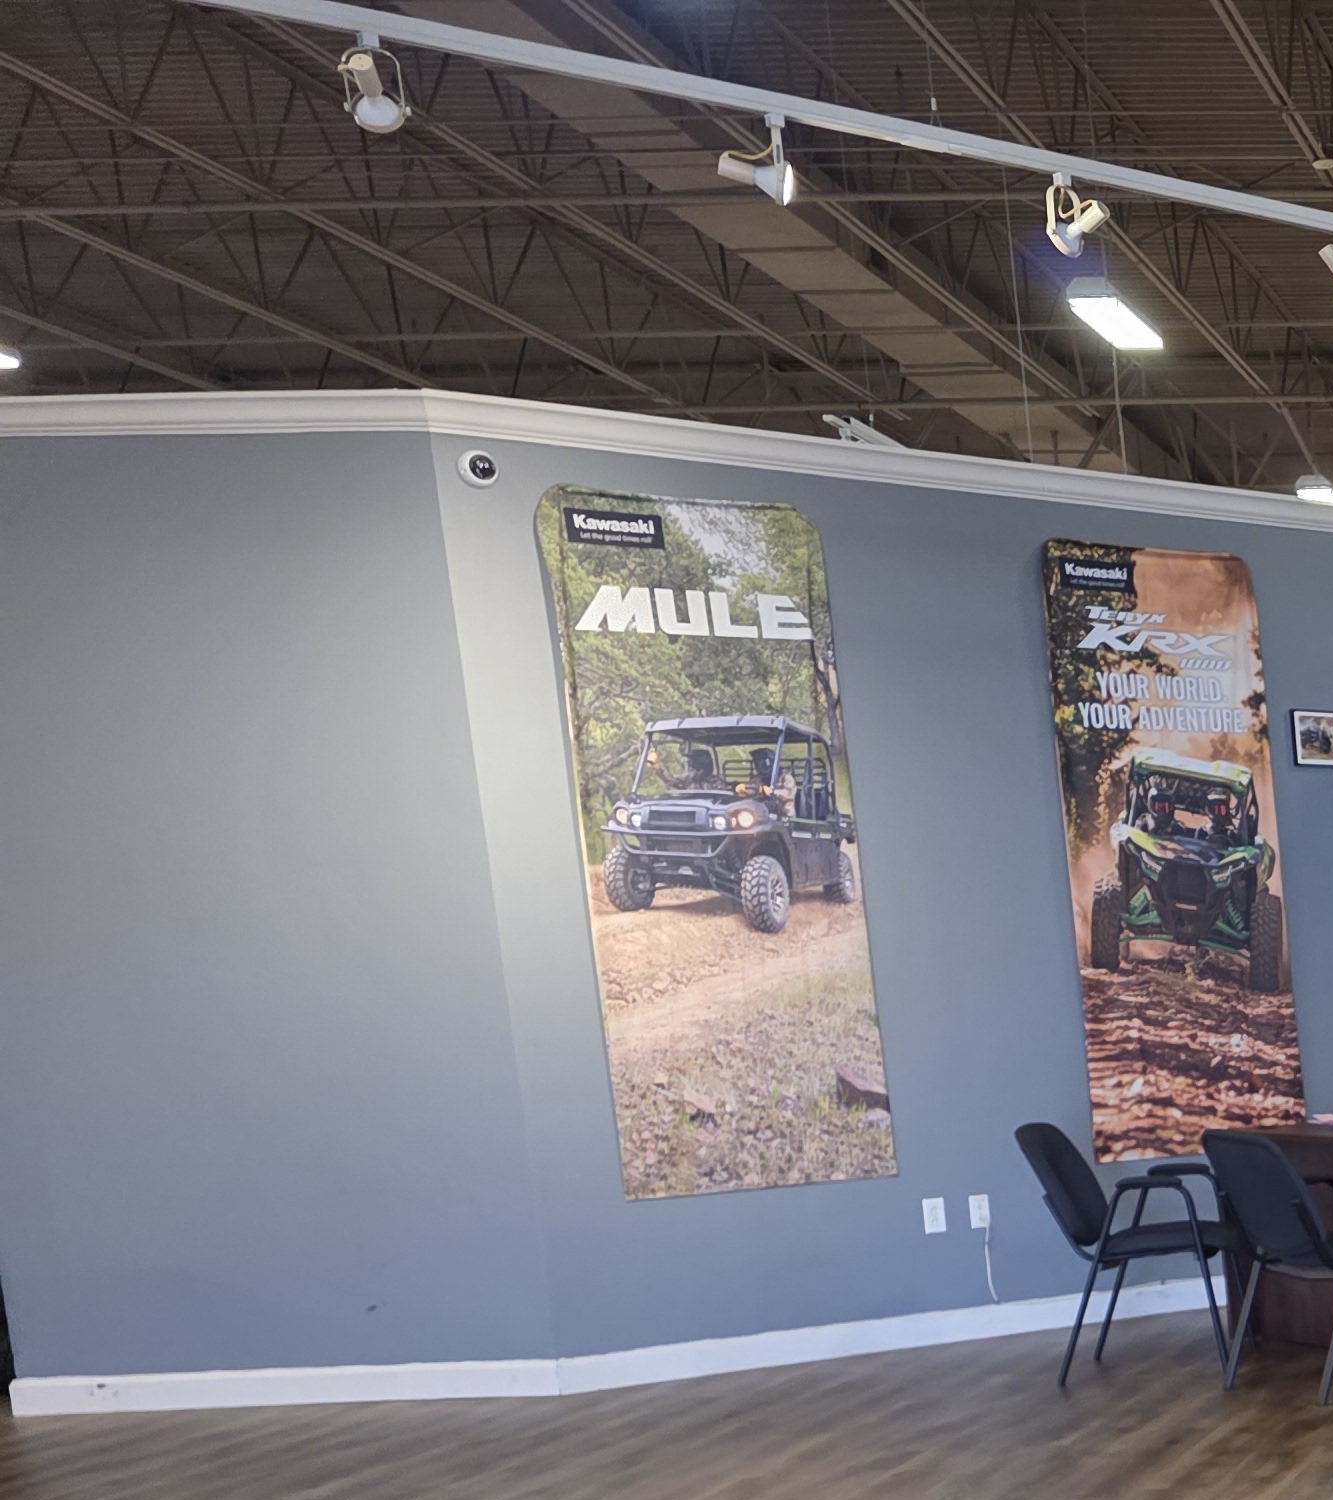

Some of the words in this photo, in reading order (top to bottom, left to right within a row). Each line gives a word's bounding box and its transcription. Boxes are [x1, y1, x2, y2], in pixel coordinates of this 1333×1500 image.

[572, 513, 655, 535] Kawasaki
[1064, 562, 1128, 581] Kawasaki
[573, 585, 815, 641] MULE
[1076, 621, 1232, 657] KRX
[1096, 671, 1149, 699] YOUR
[1155, 674, 1229, 702] WORLD.
[1077, 701, 1133, 730] YOUR
[1138, 706, 1249, 734] ADVENTURE.
